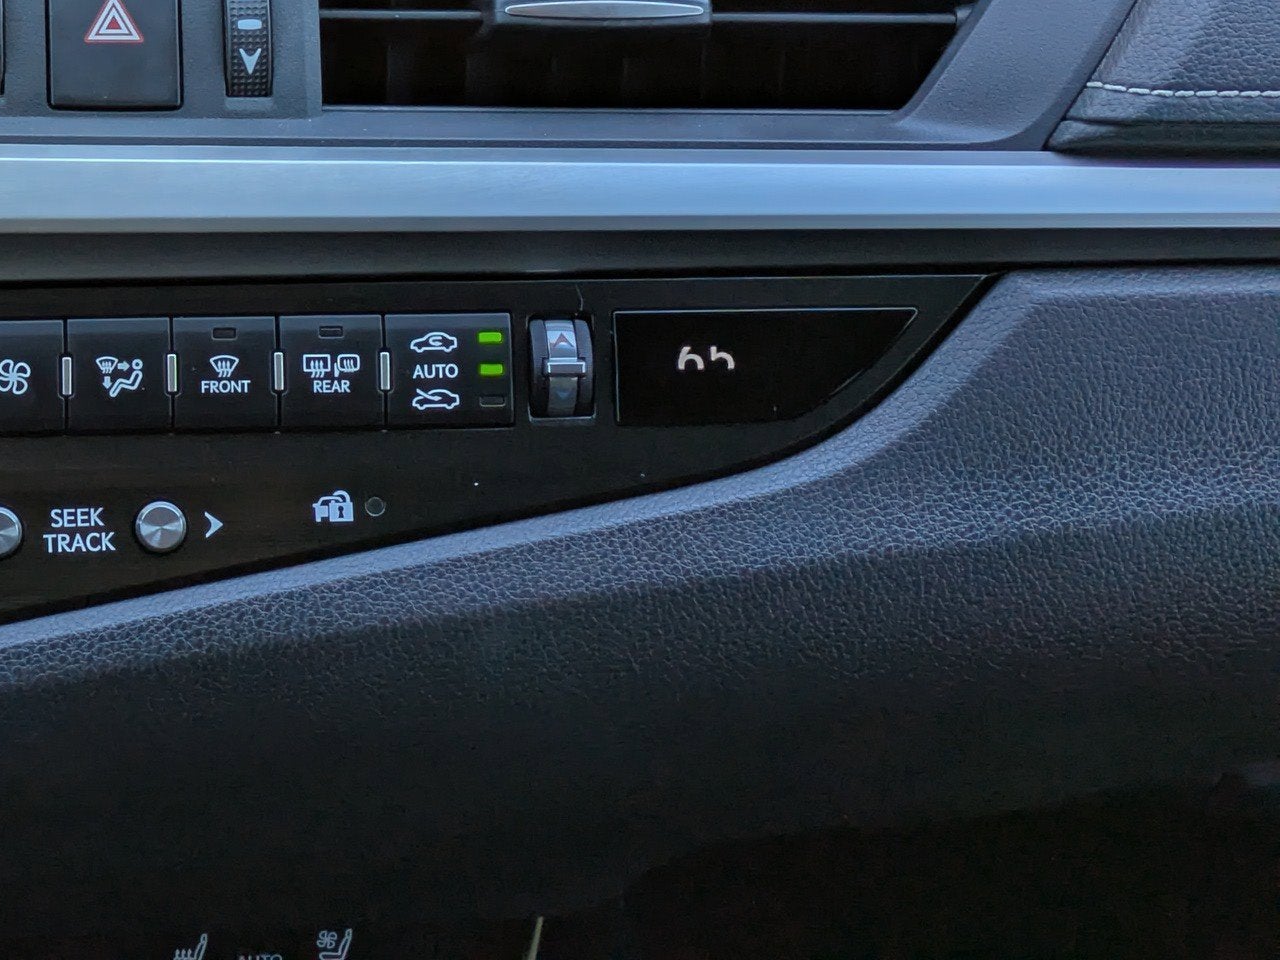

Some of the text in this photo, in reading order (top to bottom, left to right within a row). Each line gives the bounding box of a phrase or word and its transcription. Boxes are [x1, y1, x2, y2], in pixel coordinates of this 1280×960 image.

[412, 363, 459, 379] AUTO
[201, 380, 251, 395] FRONT
[313, 380, 351, 394] REAR
[50, 508, 105, 529] SEEK
[42, 532, 116, 554] TRACK
